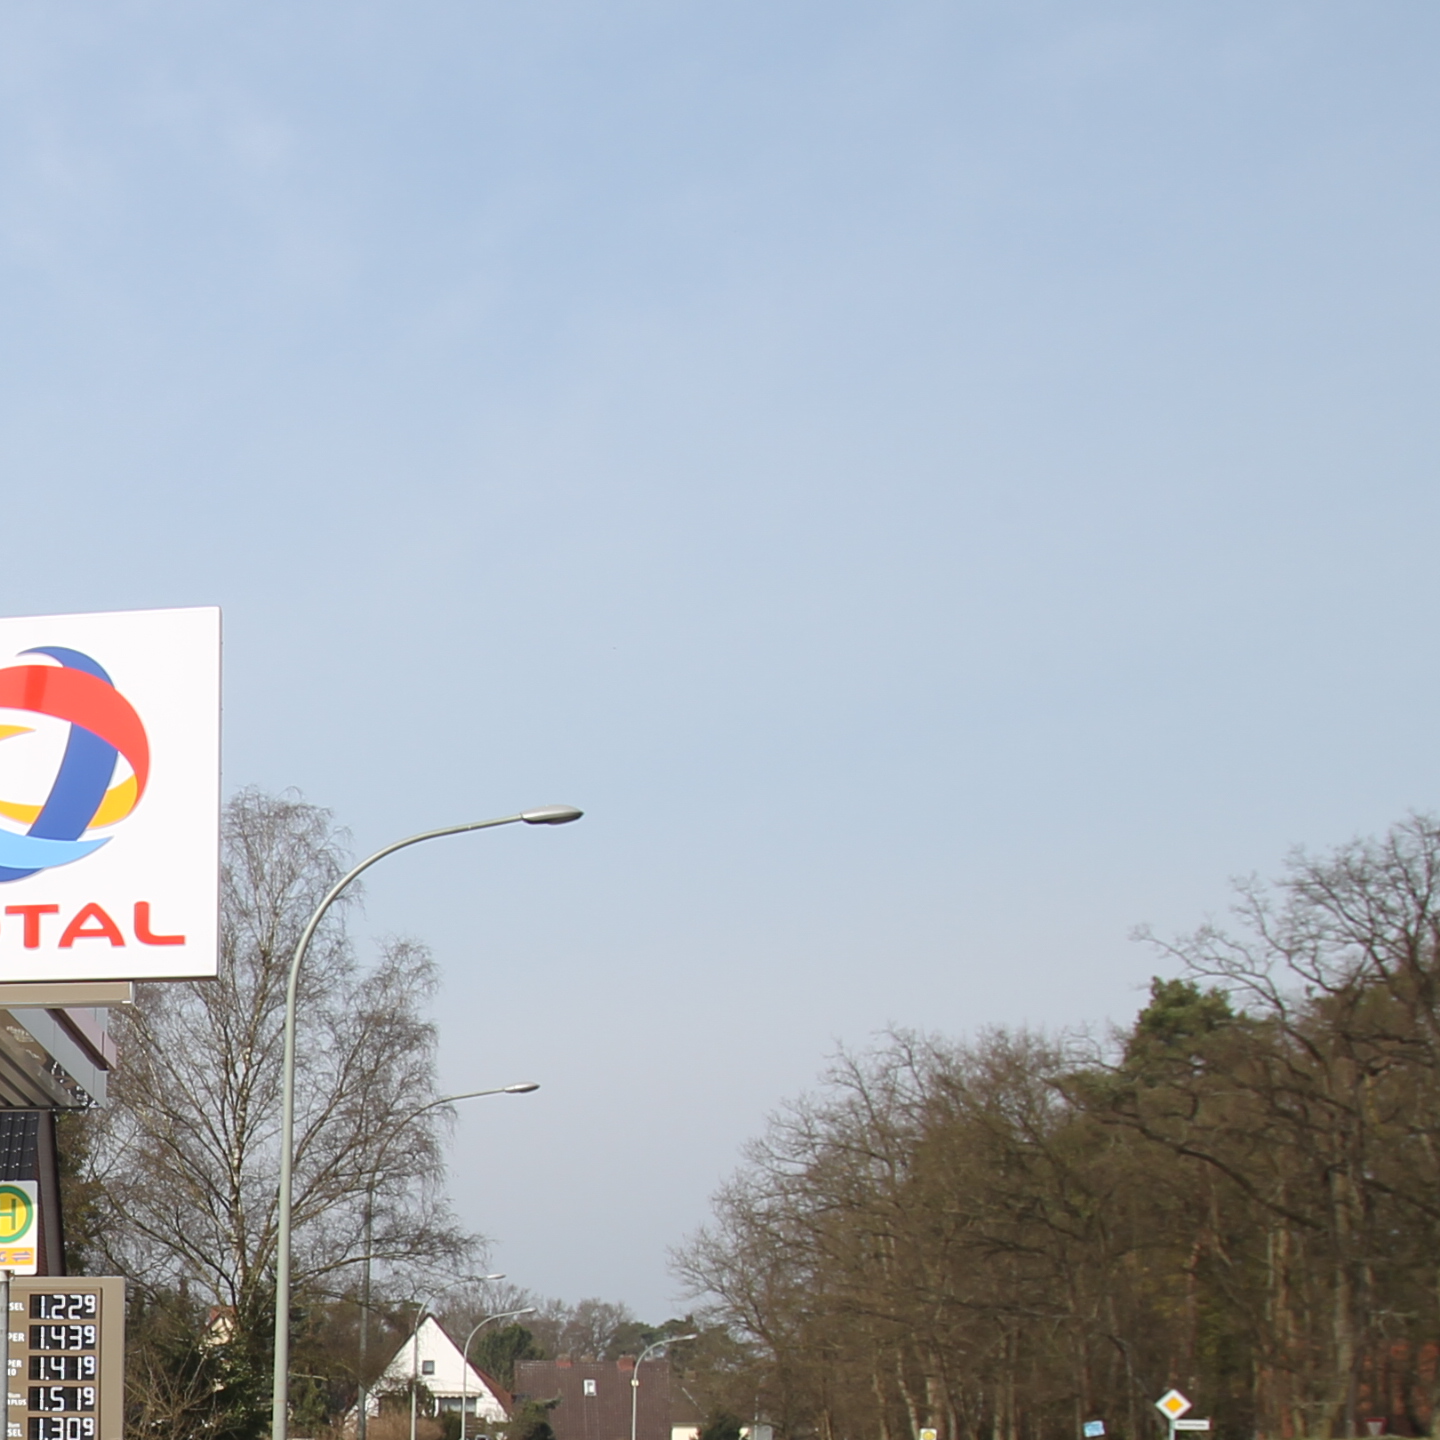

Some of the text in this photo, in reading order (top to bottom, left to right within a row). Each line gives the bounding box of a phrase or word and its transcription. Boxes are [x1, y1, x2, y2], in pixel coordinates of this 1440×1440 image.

[40, 1294, 96, 1320] 1.229
[40, 1325, 95, 1350] 1.439
[40, 1355, 95, 1380] 1.419
[39, 1386, 95, 1411] 1.519
